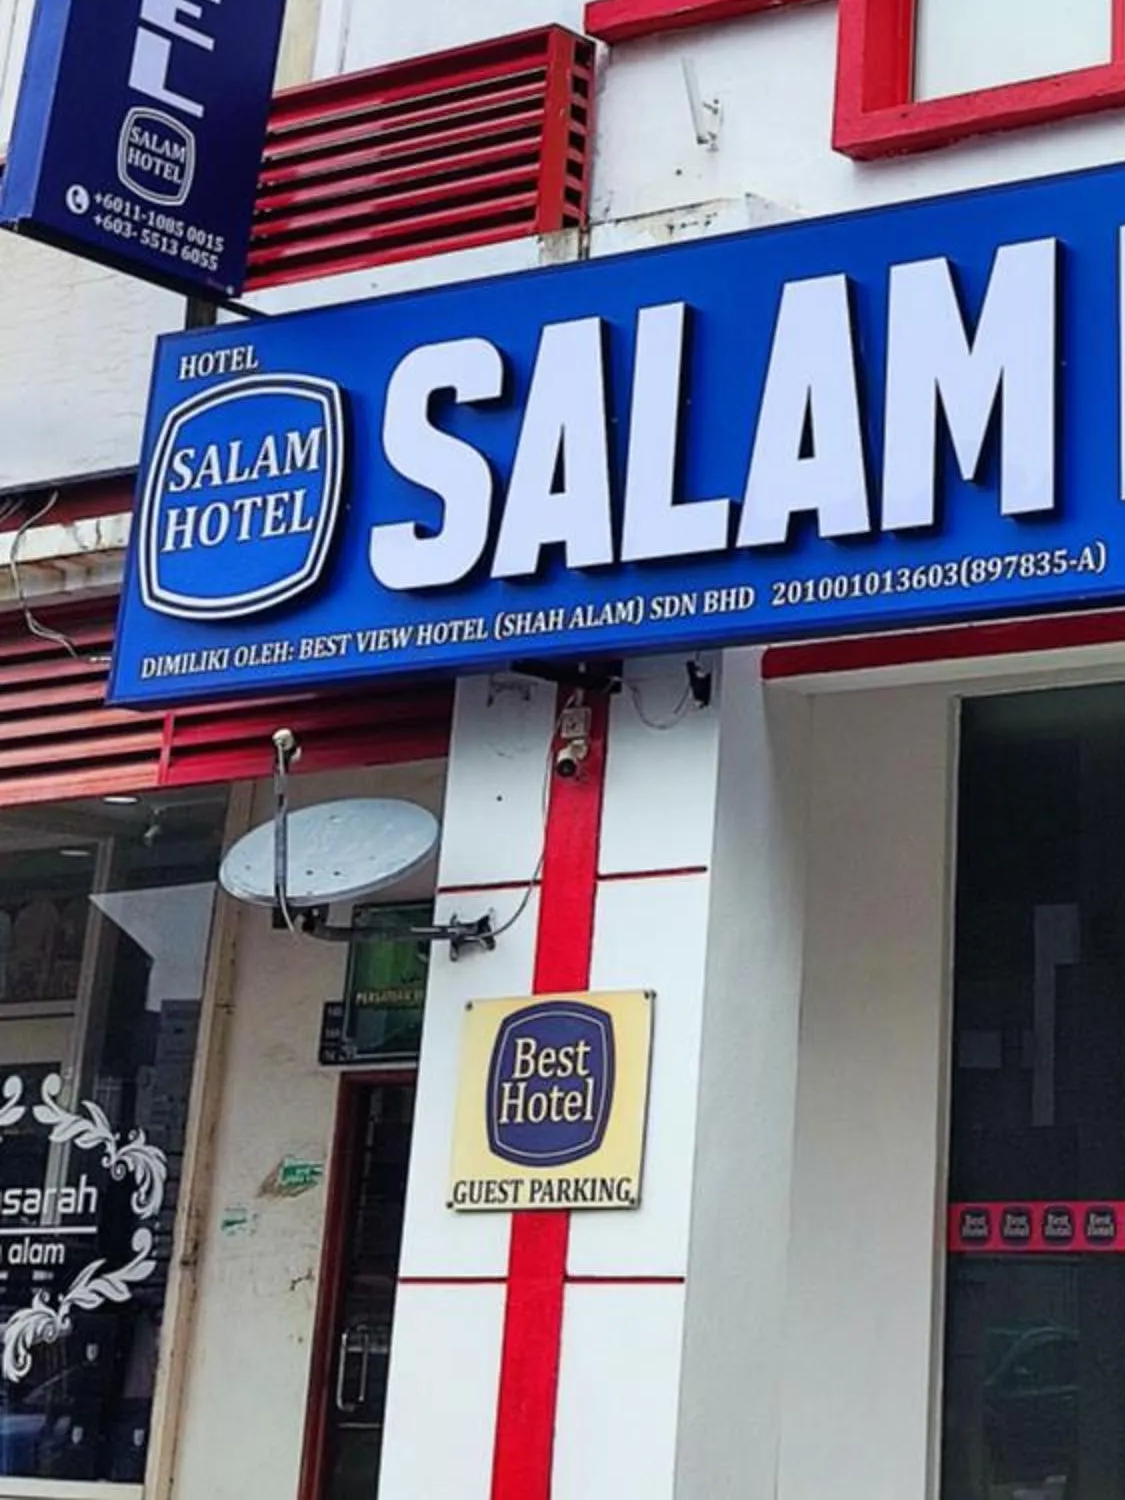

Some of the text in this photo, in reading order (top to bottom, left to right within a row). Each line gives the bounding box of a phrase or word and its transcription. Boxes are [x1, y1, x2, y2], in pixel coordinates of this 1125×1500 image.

[129, 125, 186, 164] SALAM
[127, 147, 183, 185] HOTEL
[140, 229, 179, 256] 5513
[181, 245, 219, 272] 6055
[187, 225, 225, 253] 0015
[178, 345, 259, 381] HOTEL
[369, 237, 1060, 590] SALAM
[168, 426, 324, 493] SALAM
[160, 488, 315, 553] HOTEL
[141, 540, 1108, 679] DIMILIKI OLEH: BEST VIEW HOTEL (SHAH ALAM) SDN BHD 201001013603(897835-A)
[511, 1037, 592, 1079] Best
[499, 1077, 594, 1124] Hotel
[453, 1177, 632, 1205] GUEST PARKING
[7, 1236, 66, 1265] alam
